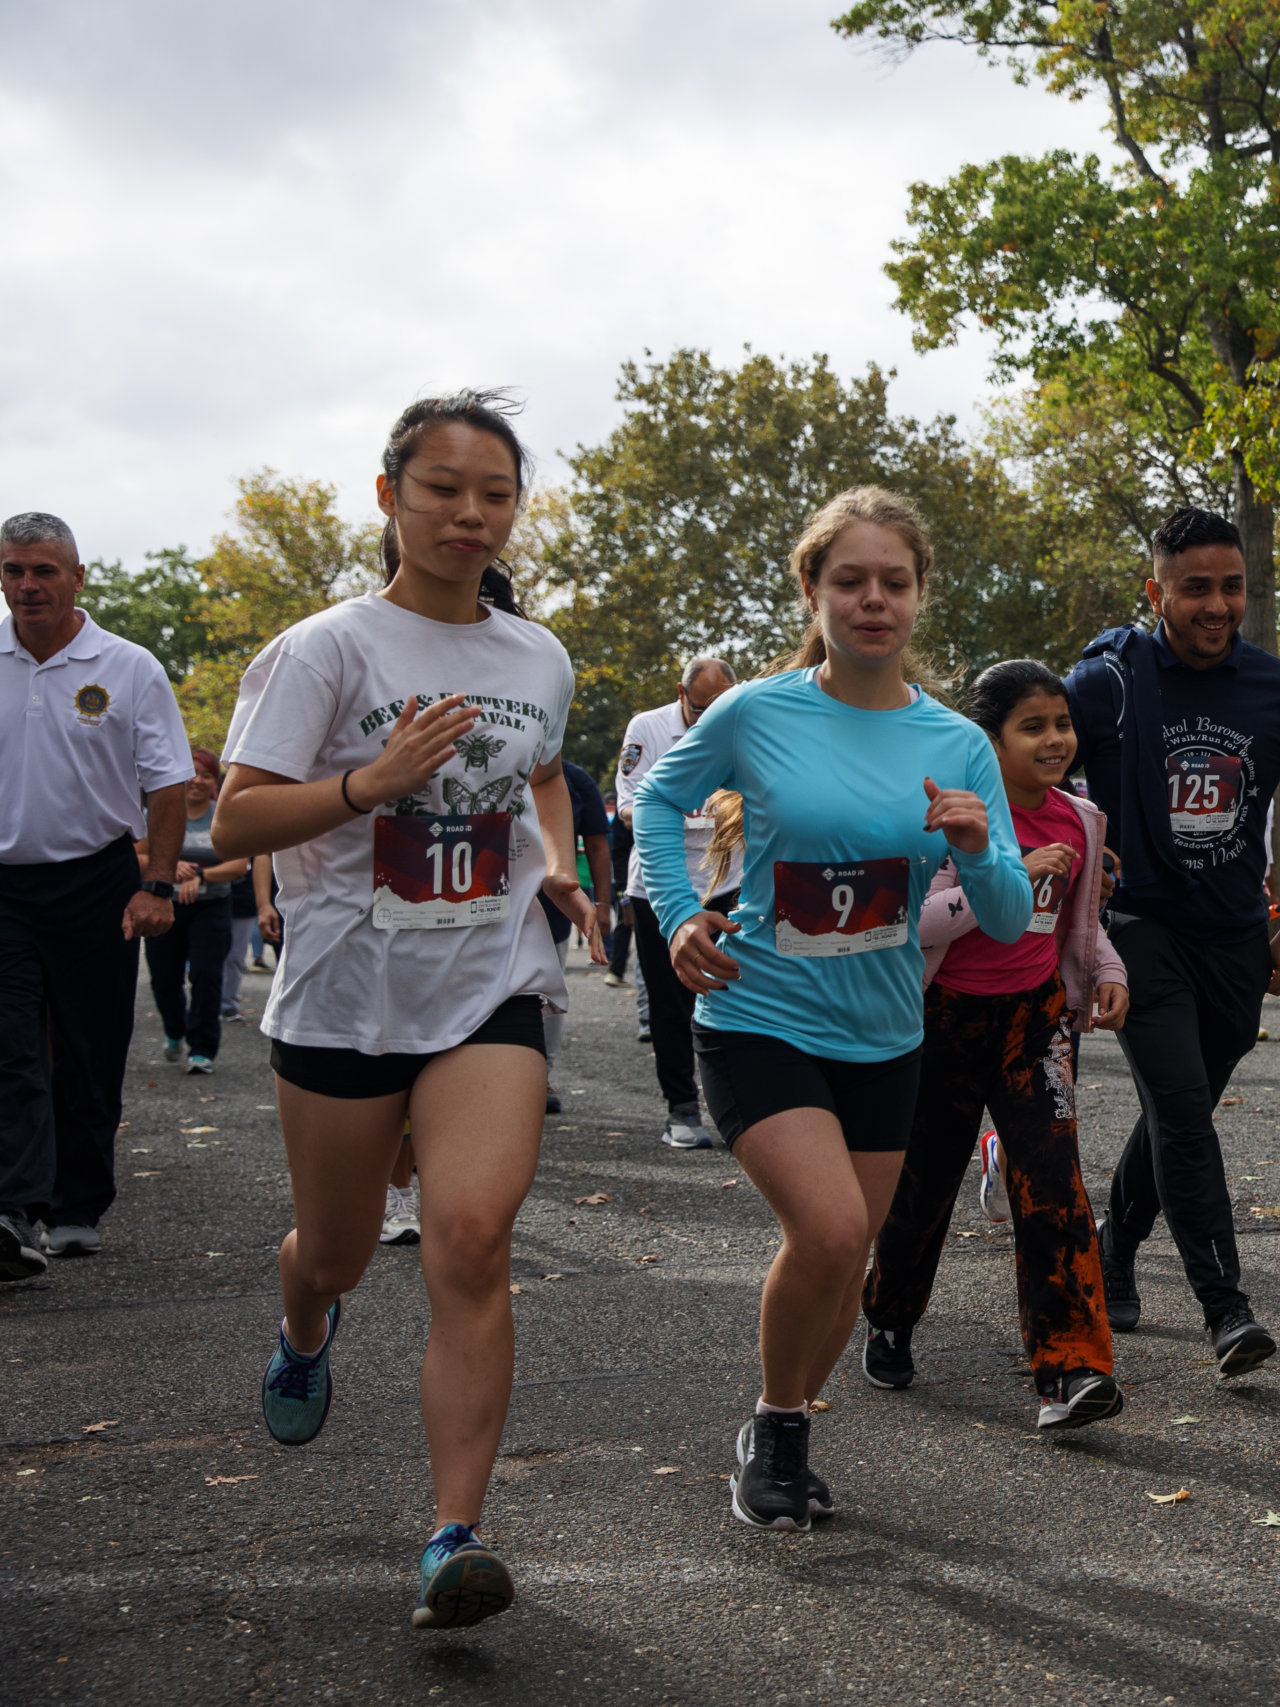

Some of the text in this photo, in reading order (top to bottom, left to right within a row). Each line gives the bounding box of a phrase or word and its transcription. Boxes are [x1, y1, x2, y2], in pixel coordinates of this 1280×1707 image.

[1162, 716, 1254, 748] trol Borough
[1170, 734, 1221, 745] Walk/Run
[1223, 741, 1238, 750] for
[1168, 774, 1220, 809] 125
[446, 825, 463, 833] ROAD
[426, 842, 472, 895] 10
[1210, 838, 1247, 867] North
[832, 884, 854, 928] 9
